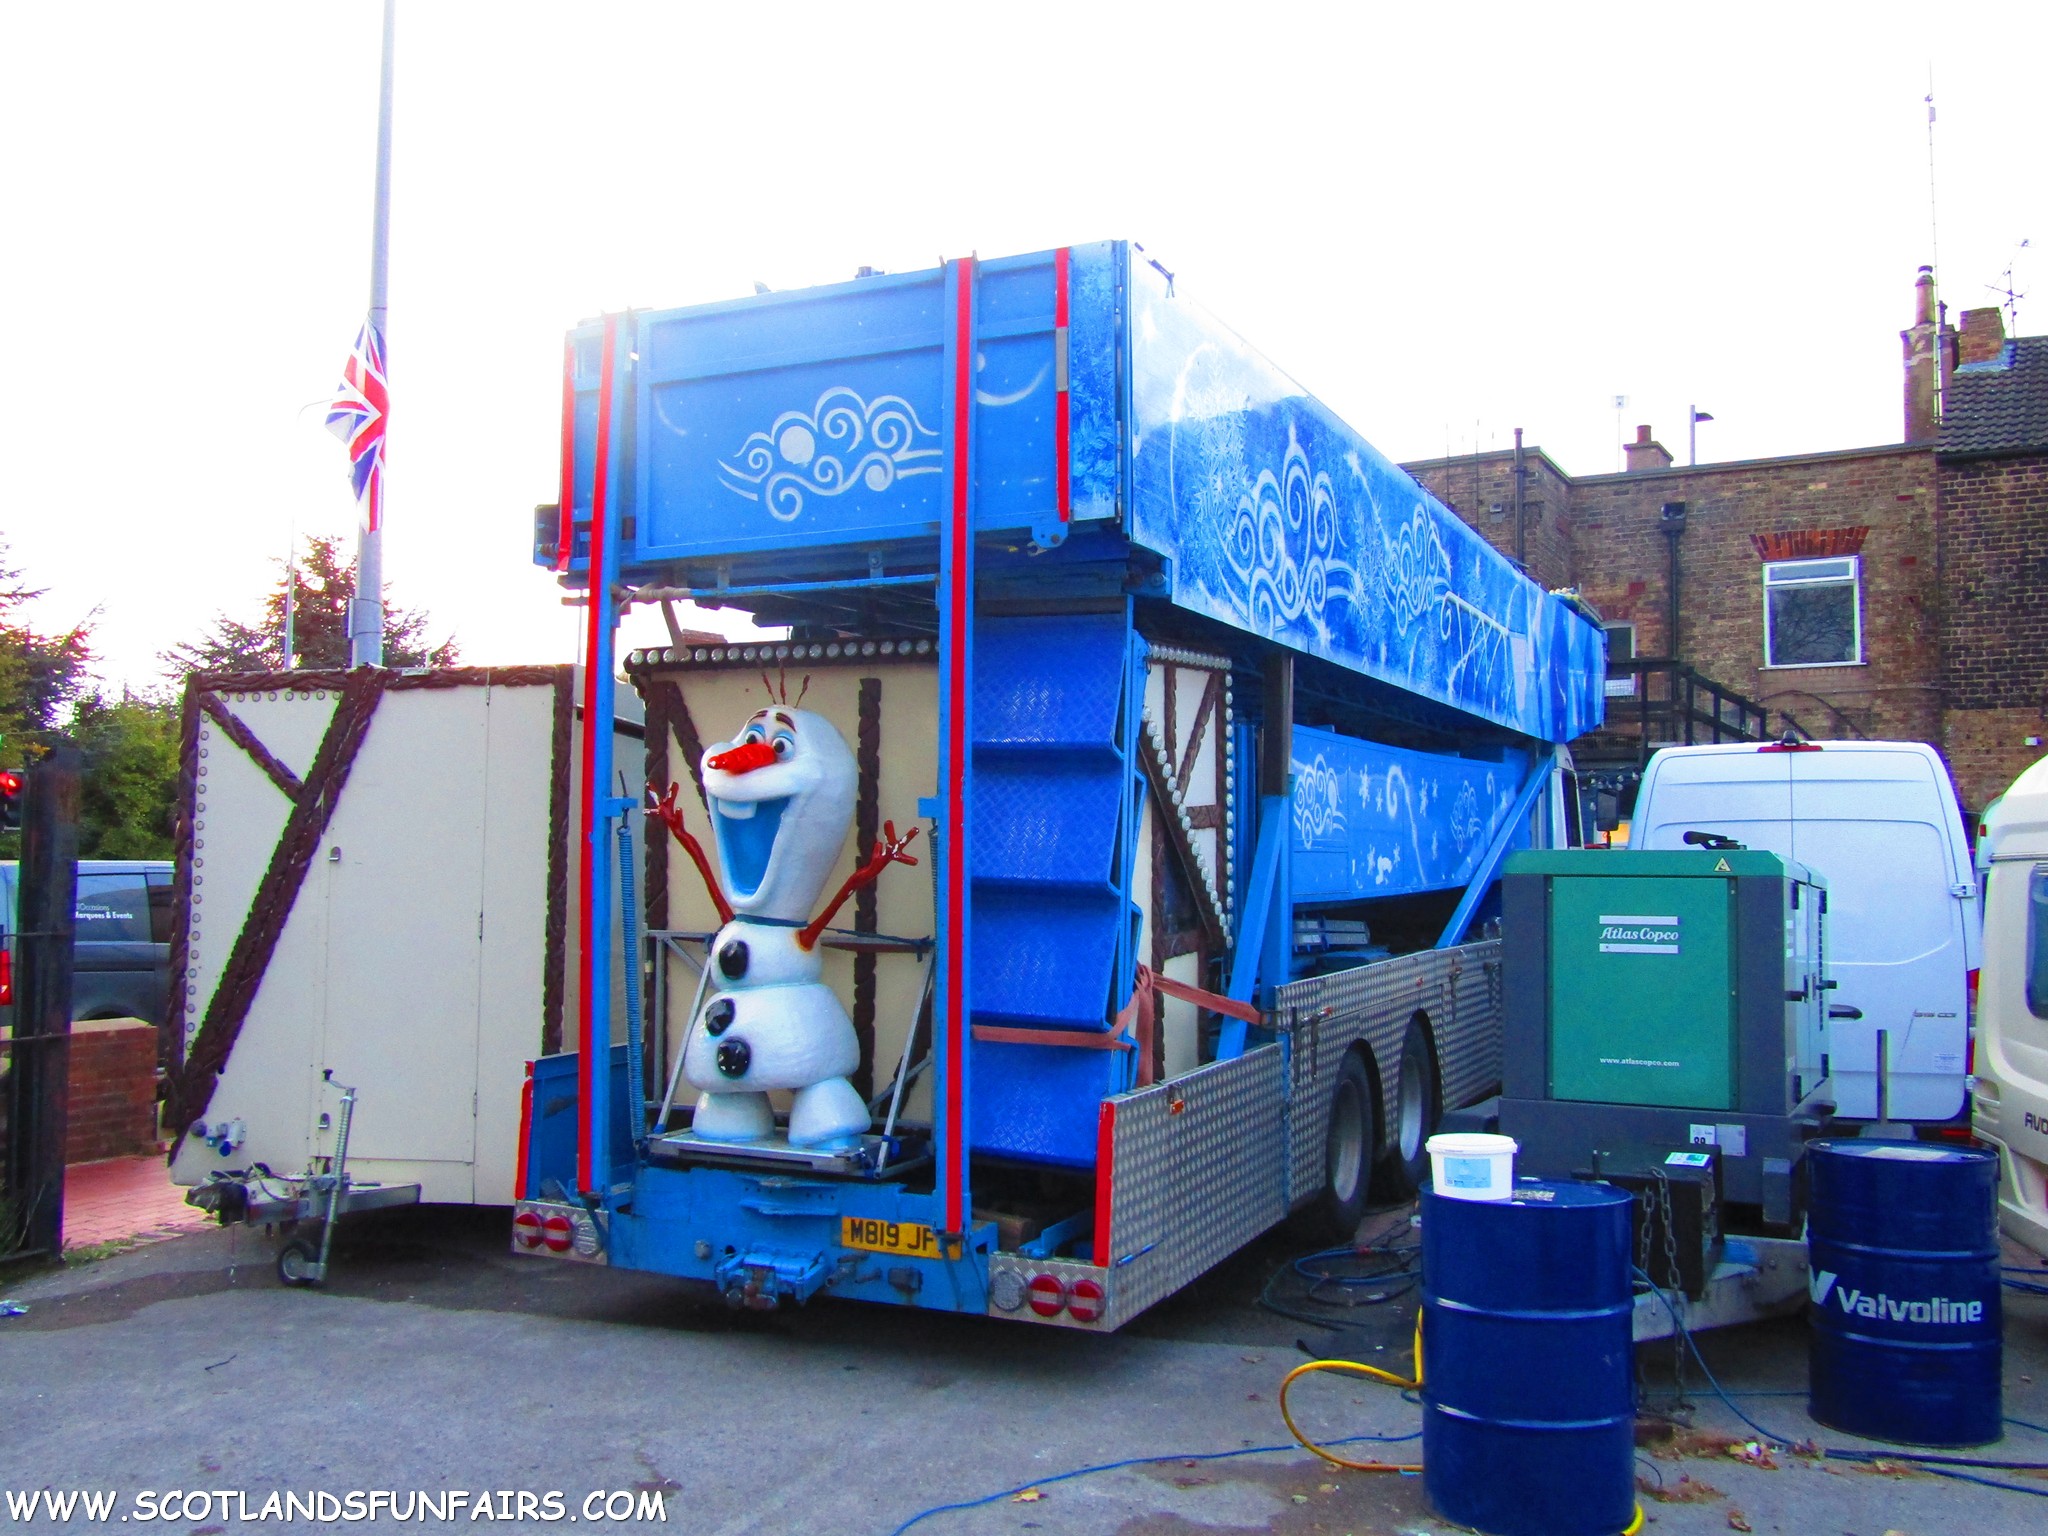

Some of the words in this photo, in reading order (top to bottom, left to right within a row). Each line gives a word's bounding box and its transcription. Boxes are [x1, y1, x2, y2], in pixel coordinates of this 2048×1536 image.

[106, 911, 111, 919] &
[112, 911, 133, 919] Events
[1600, 927, 1638, 940] Atlas
[1639, 928, 1679, 942] Copco
[1600, 1058, 1680, 1067] www.atlascopco.com
[850, 1219, 900, 1248] M819
[1837, 1285, 1982, 1324] Valvoline
